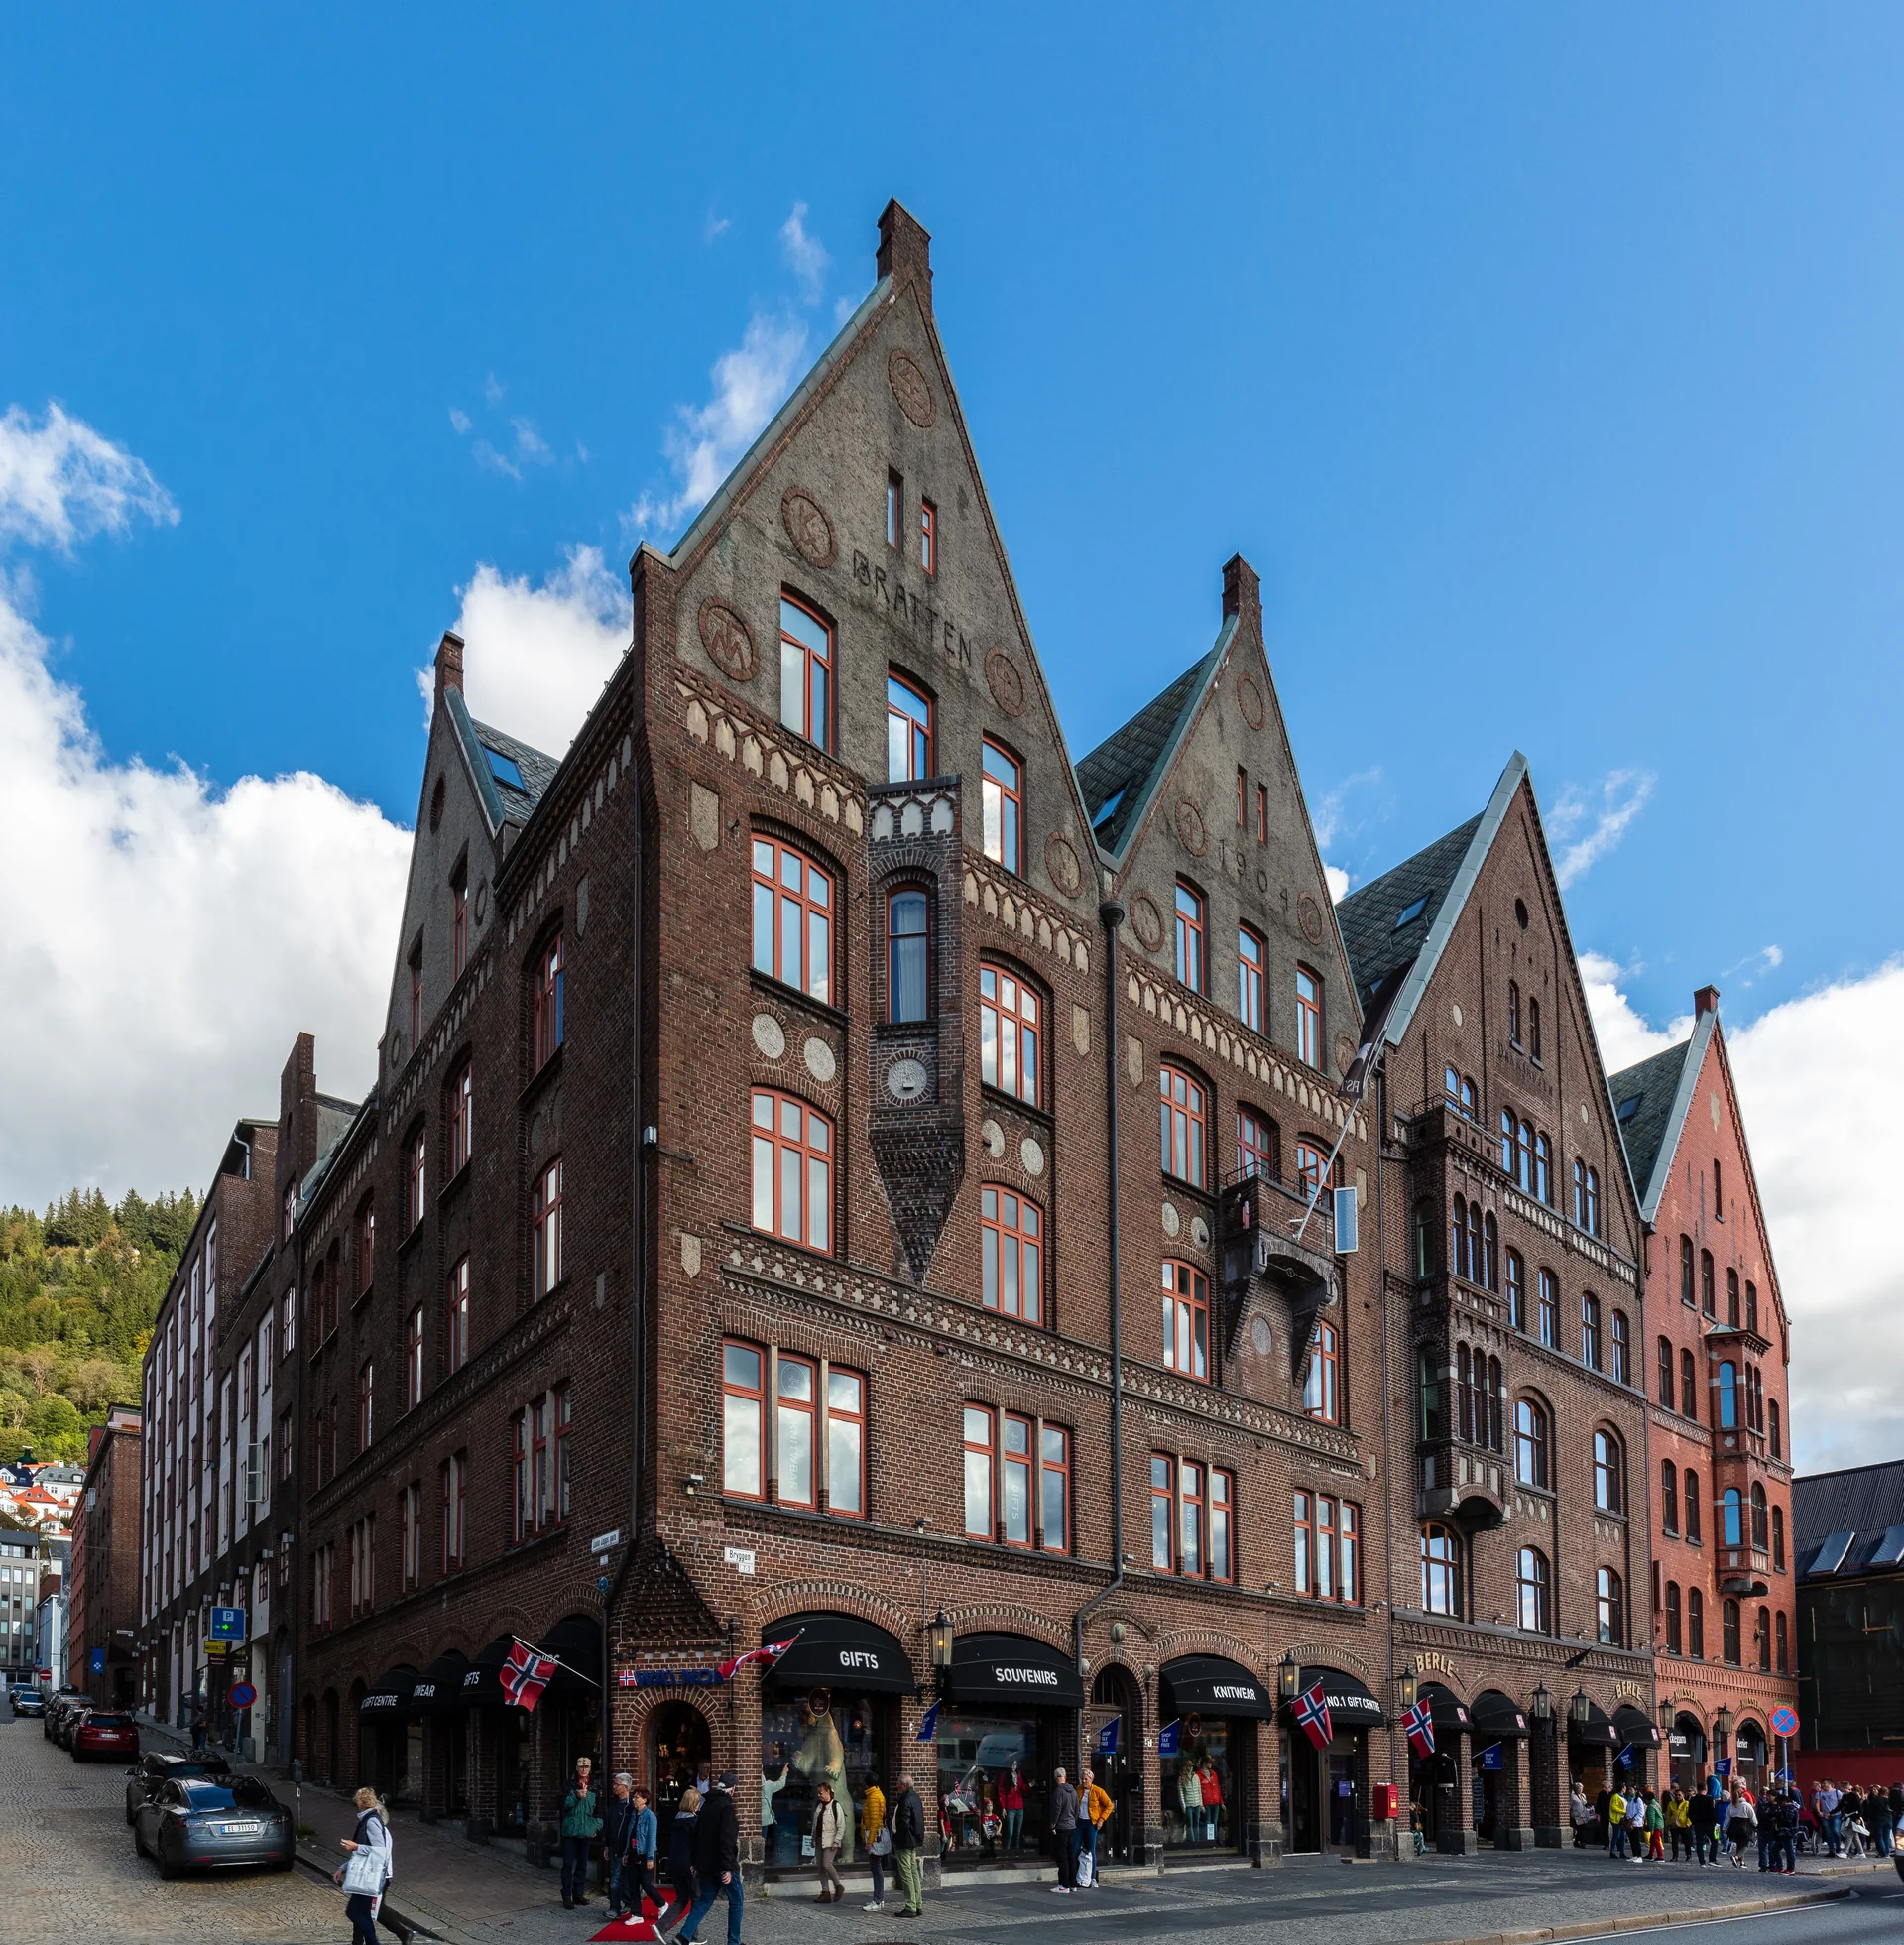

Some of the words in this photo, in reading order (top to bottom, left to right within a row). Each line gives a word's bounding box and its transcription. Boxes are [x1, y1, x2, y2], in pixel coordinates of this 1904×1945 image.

[853, 548, 972, 667] BRATTEN
[1011, 1484, 1019, 1520] GIFTS
[729, 1549, 751, 1562] Bryggen
[840, 1650, 879, 1670] GIFTS
[1414, 1652, 1455, 1678] BERLE
[995, 1667, 1058, 1685] SOUVENIRS
[1213, 1686, 1256, 1701] KNITWEAR
[1615, 1681, 1642, 1701] BERLE
[1674, 1687, 1698, 1702] NILSSEN
[374, 1695, 399, 1707] CENTRE
[1327, 1695, 1347, 1707] NO.1
[1348, 1696, 1363, 1708] GIFT
[1363, 1697, 1381, 1713] CENTRE
